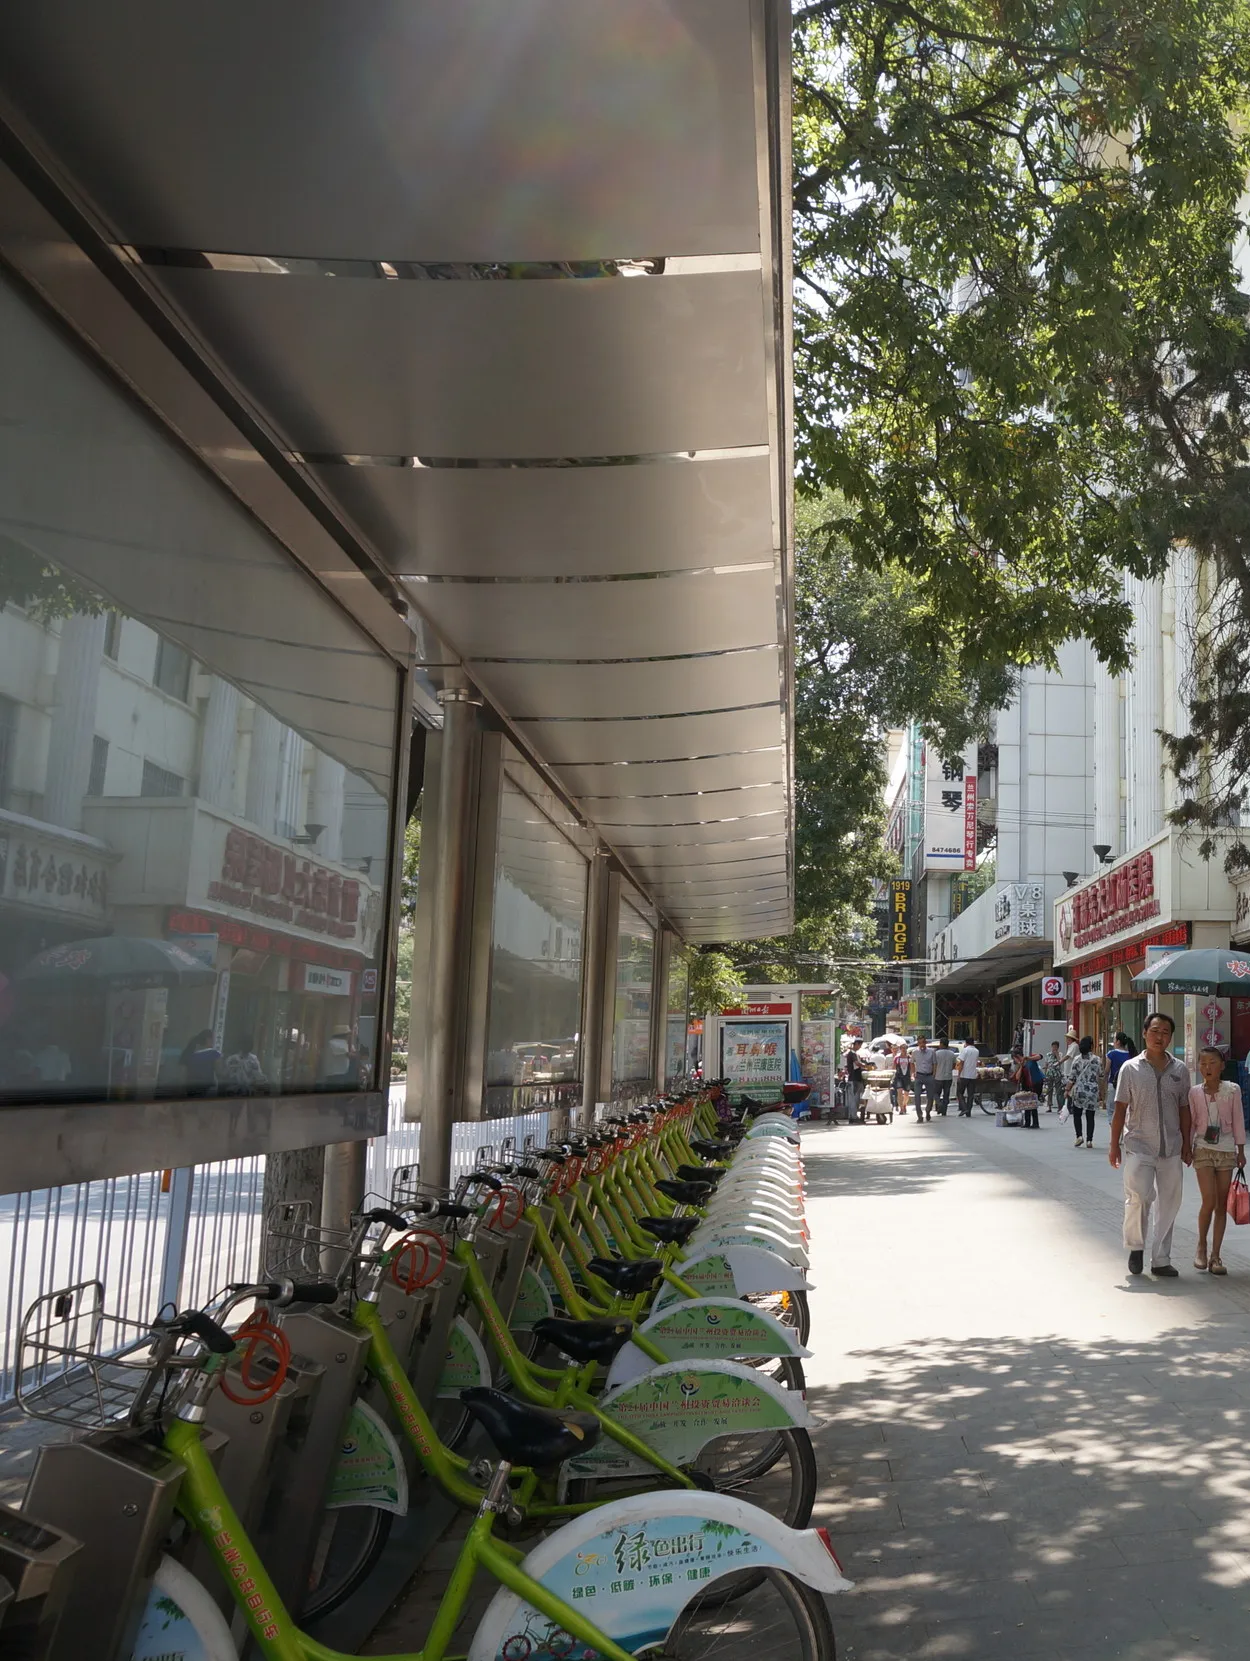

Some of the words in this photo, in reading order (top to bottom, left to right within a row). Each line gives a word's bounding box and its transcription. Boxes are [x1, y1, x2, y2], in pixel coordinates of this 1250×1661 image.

[891, 881, 911, 891] 1919
[894, 893, 907, 953] BRIDGE
[1019, 902, 1036, 936] 桌球
[1047, 982, 1060, 991] 24
[736, 1042, 777, 1057] 耳鼻喉
[613, 1531, 706, 1575] 绿色出行
[213, 1531, 279, 1640] 兰州公共自行车
